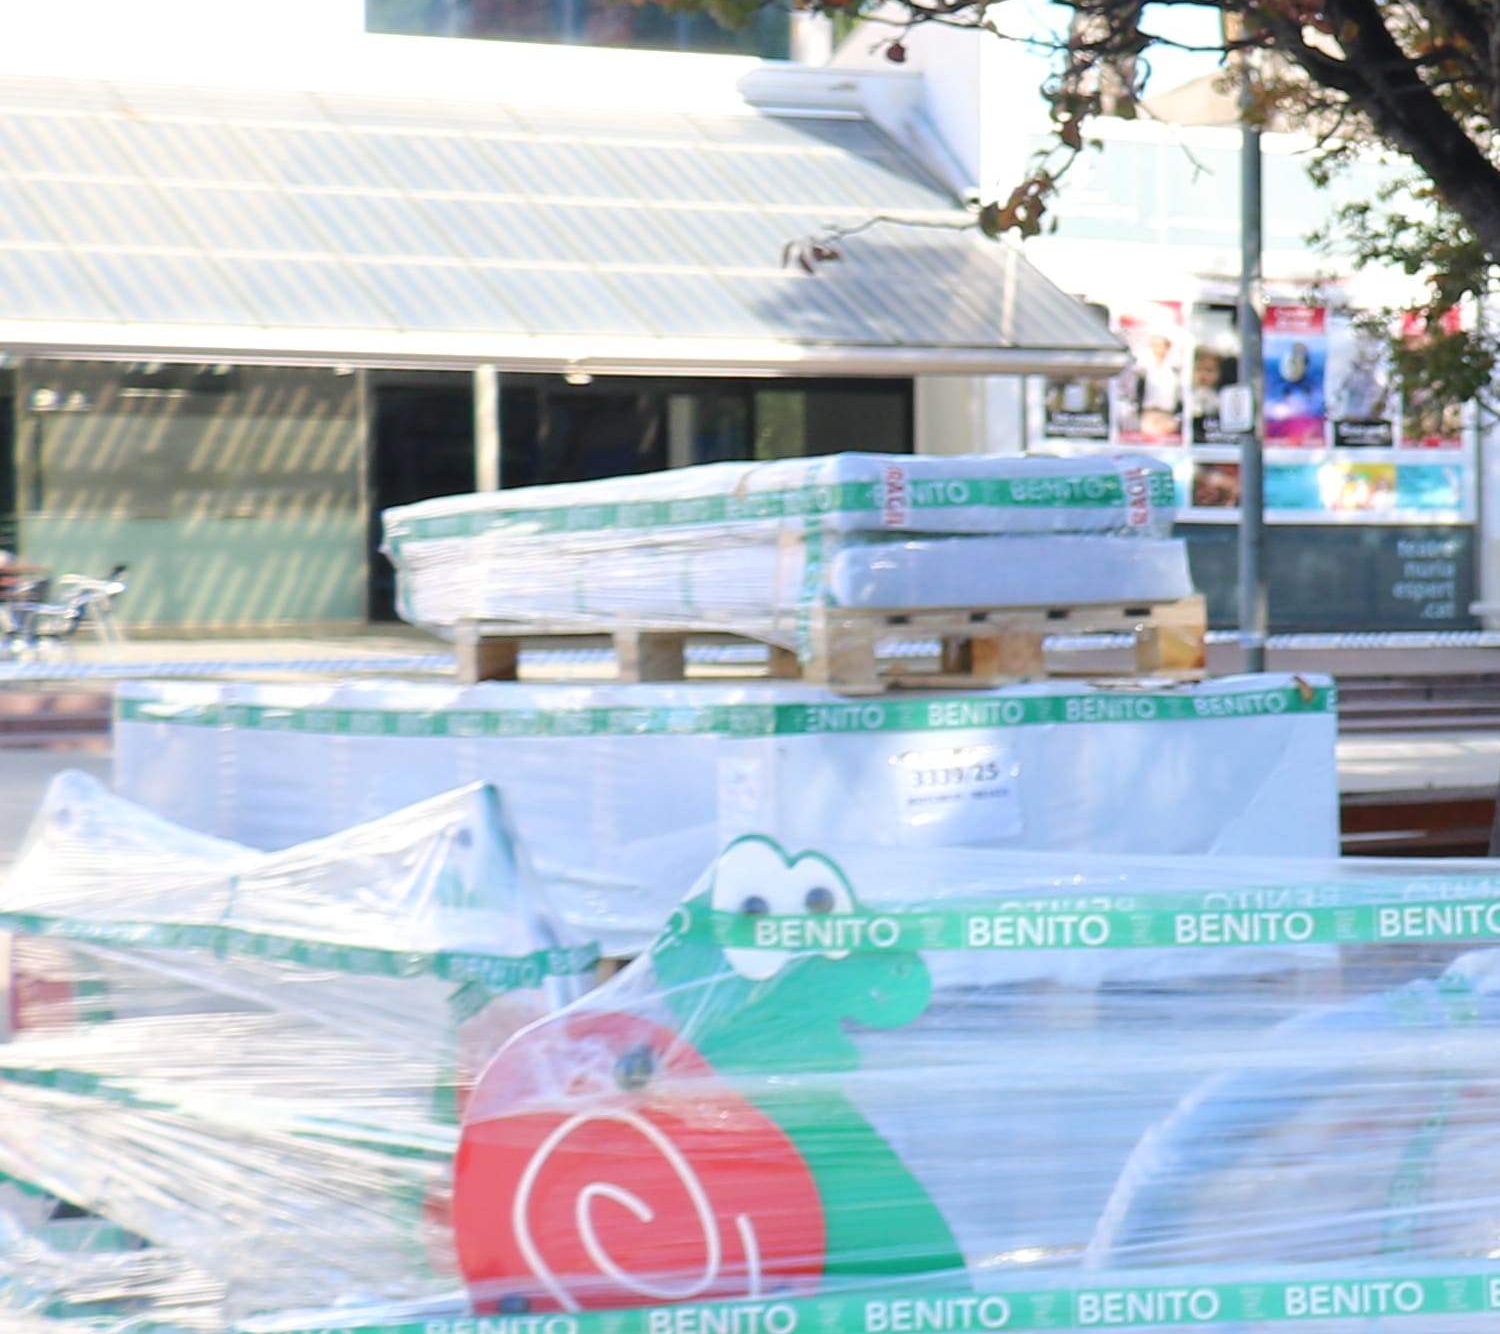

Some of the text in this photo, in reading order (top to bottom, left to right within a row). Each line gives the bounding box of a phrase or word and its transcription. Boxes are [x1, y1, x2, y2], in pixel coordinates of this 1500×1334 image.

[928, 688, 1288, 727] BENITO BENITO BENITO
[755, 917, 899, 949] BENITO
[968, 913, 1110, 948] BENITO
[1175, 909, 1314, 944] BENITO
[865, 1297, 1011, 1333] BENITO
[1078, 1289, 1220, 1326] BENITO
[1285, 1281, 1424, 1317] BENITO
